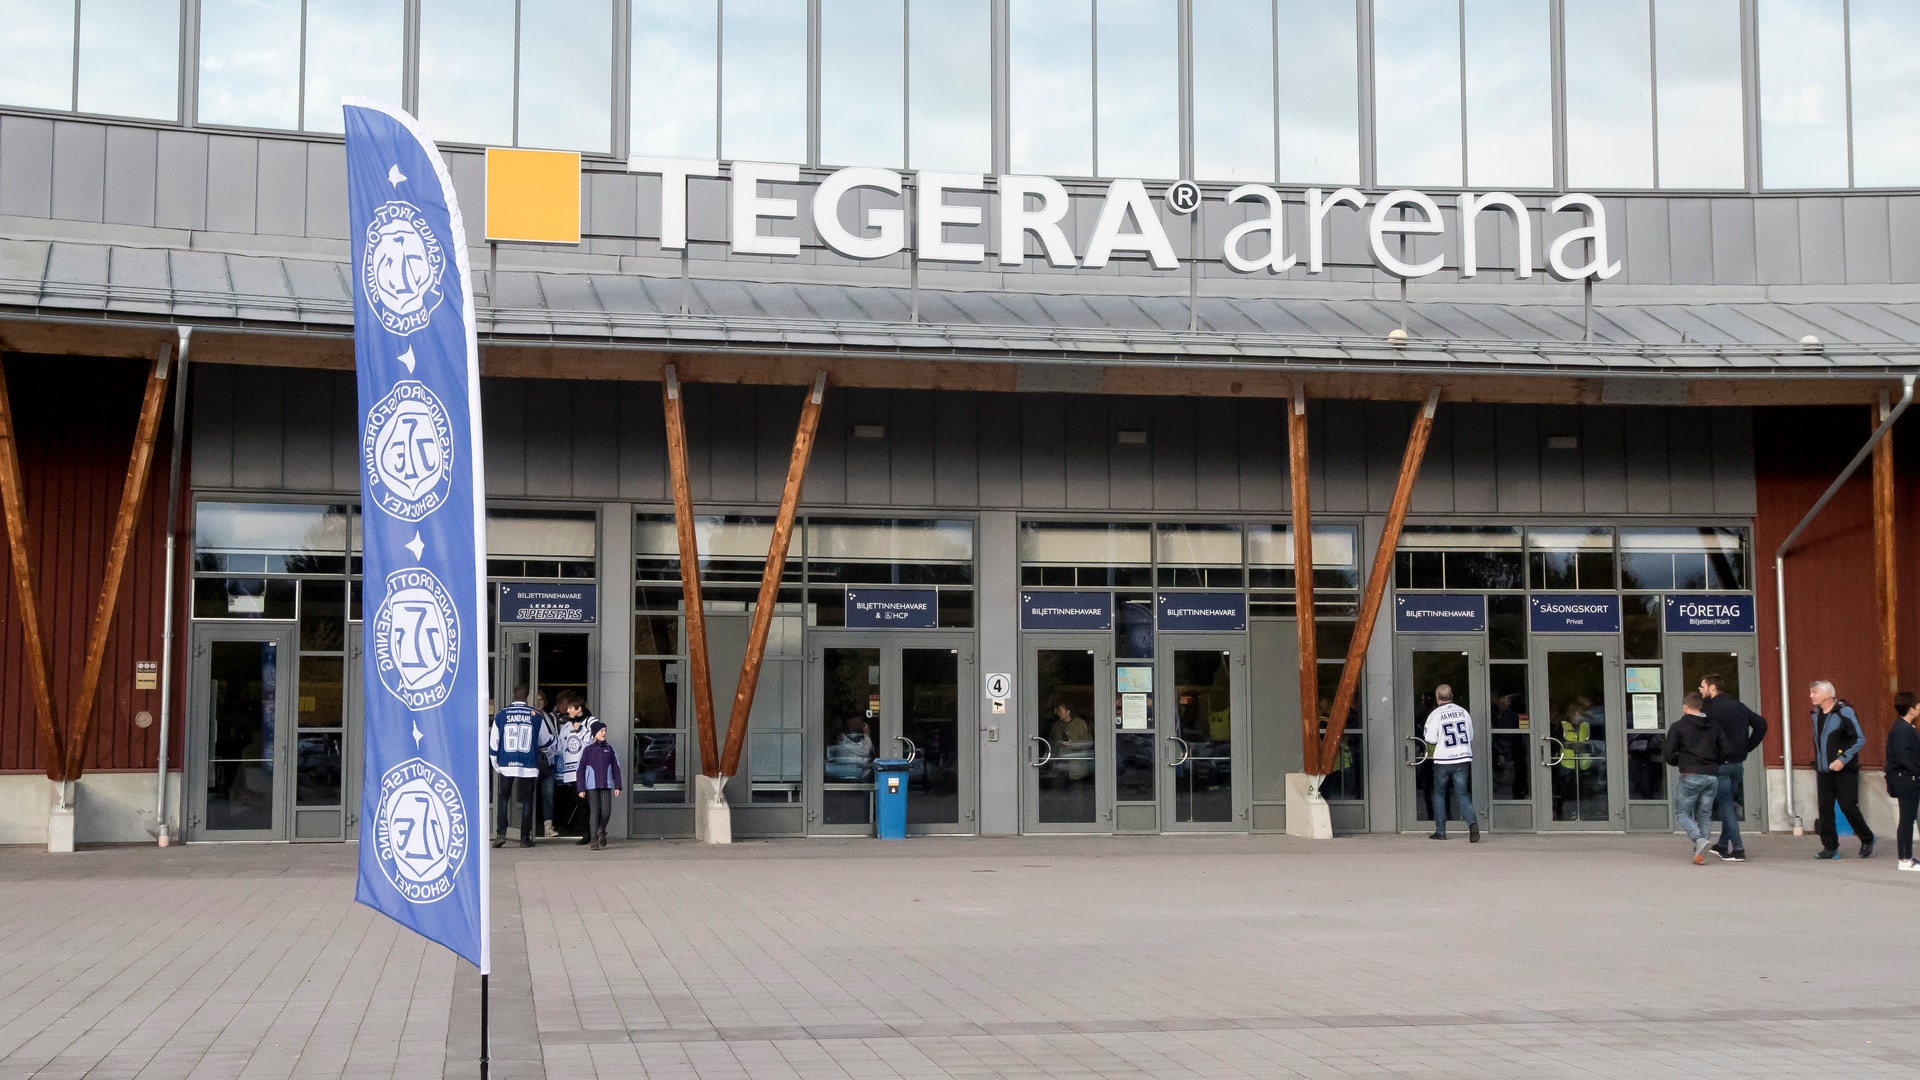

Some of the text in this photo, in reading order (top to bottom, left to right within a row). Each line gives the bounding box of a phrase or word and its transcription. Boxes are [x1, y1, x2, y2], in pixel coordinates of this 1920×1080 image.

[1220, 183, 1622, 283] arena
[517, 592, 582, 600] BILJETTINNEHAVARE
[856, 602, 927, 611] BILJETTINNEHAVARE
[1540, 603, 1609, 613] SÄSONGSKORT
[1679, 602, 1740, 617] FÖRETAG
[516, 608, 583, 620] SUPERSTARS
[875, 611, 881, 619] &
[1031, 607, 1102, 616] BILJETTINNEHAVARE
[1167, 608, 1236, 617] BILJETTINNEHAVARE
[1405, 610, 1475, 618] BILJETTINNEHAVARE
[1689, 618, 1730, 626] Biljetter/Kort
[993, 678, 1003, 693] 4
[503, 723, 533, 753] 60
[1442, 720, 1470, 748] 55
